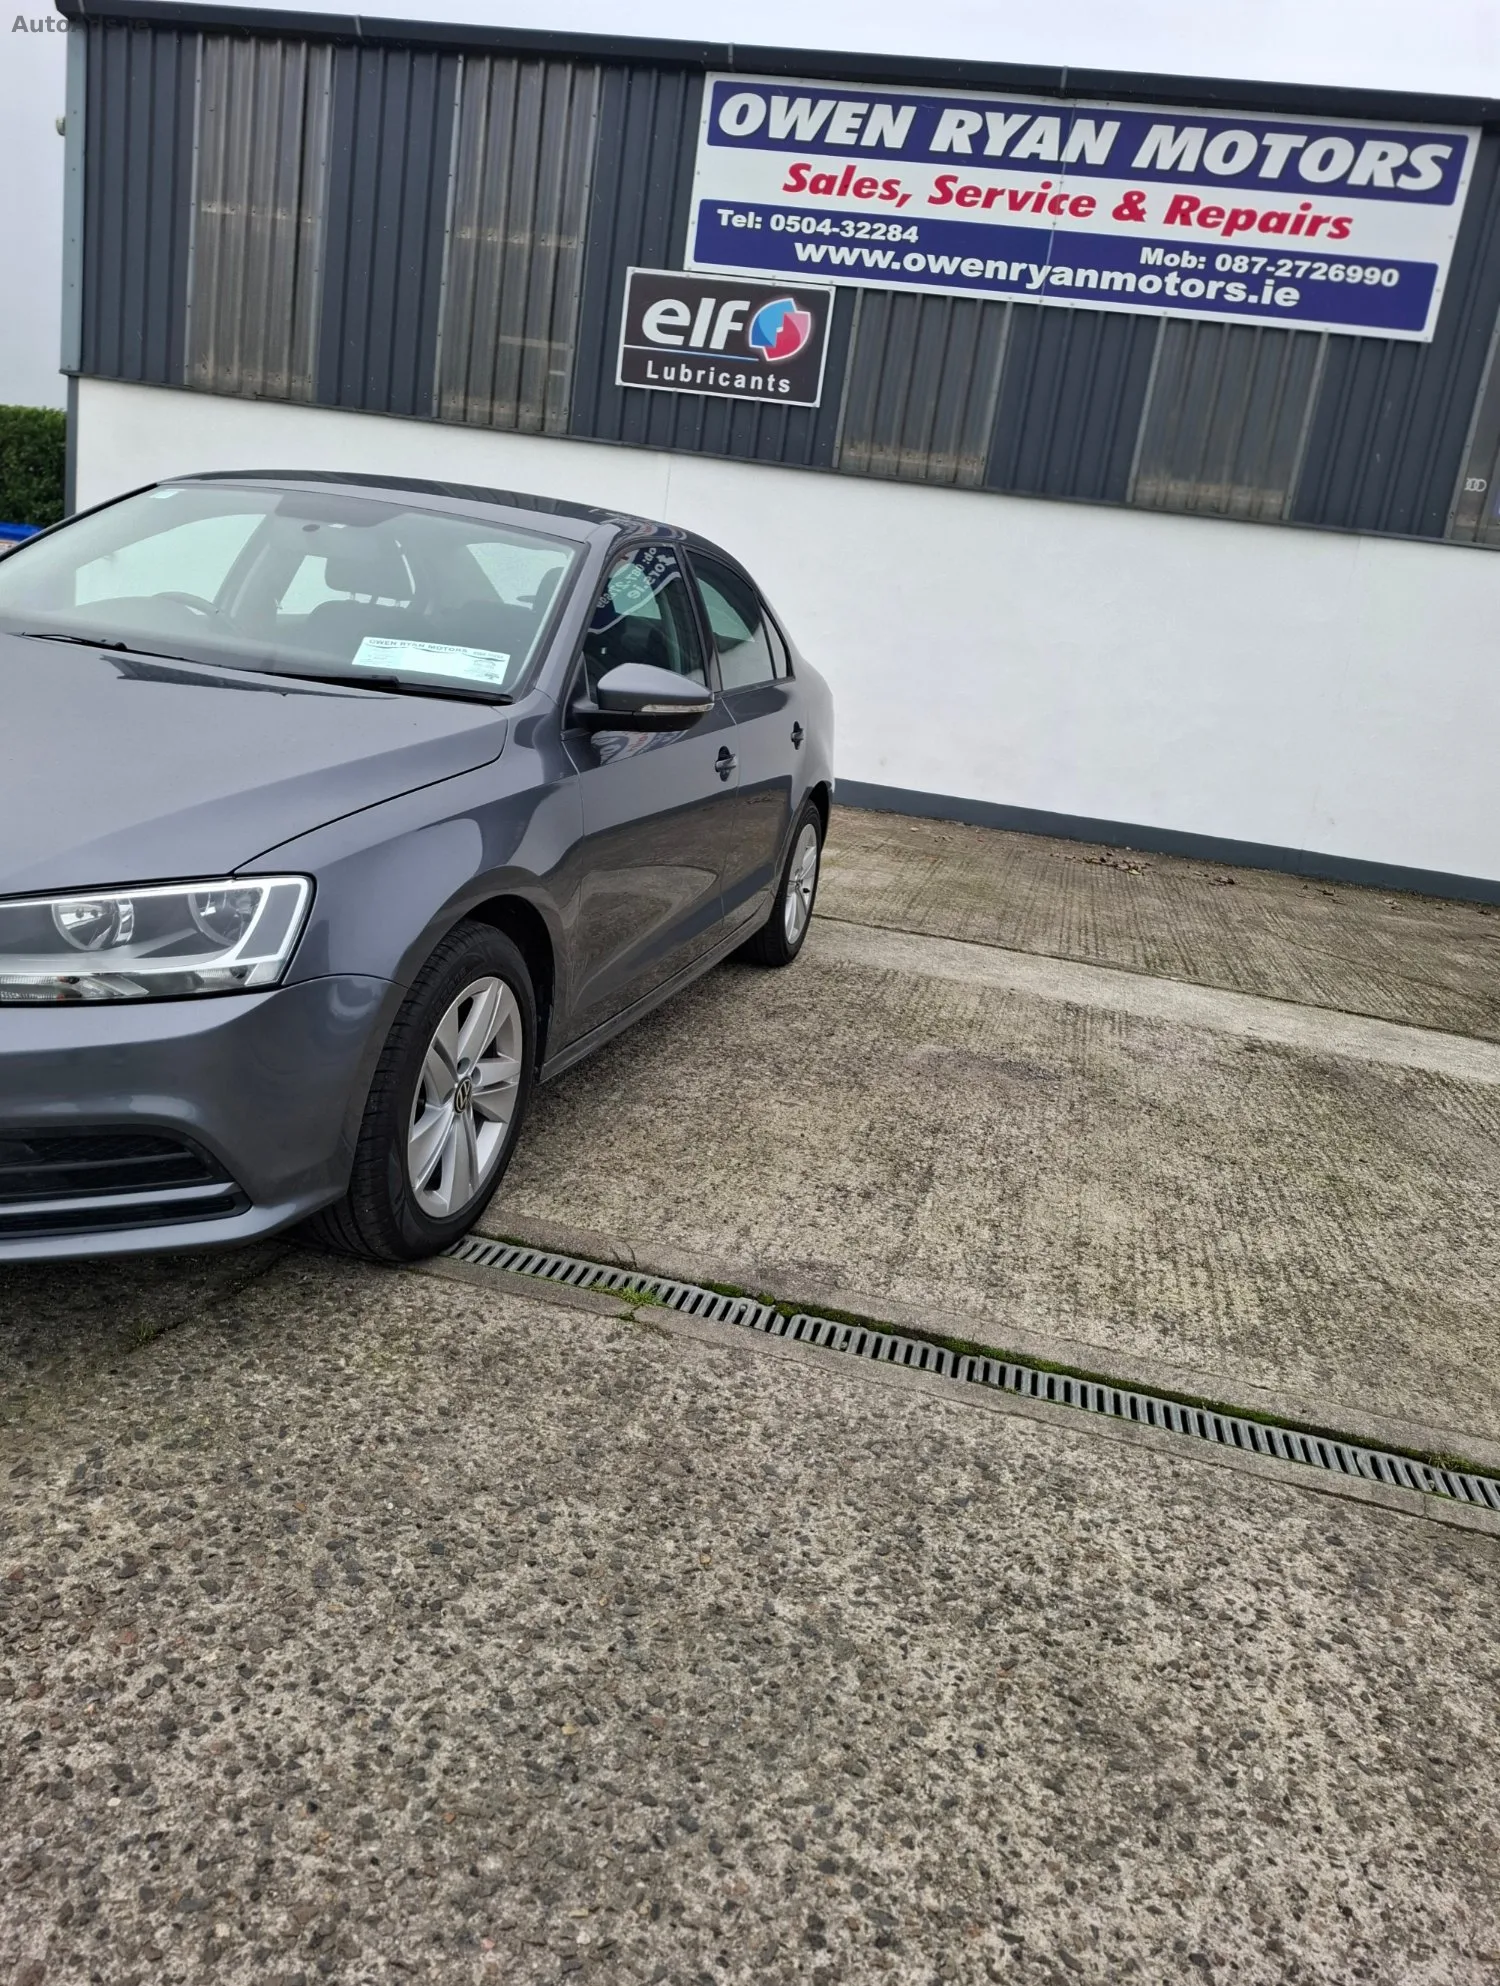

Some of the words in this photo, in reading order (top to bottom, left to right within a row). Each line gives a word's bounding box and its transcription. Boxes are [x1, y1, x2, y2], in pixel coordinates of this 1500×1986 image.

[718, 92, 917, 149] OWEN
[929, 108, 1120, 165] RYAN
[1131, 124, 1453, 191] MOTORS
[782, 162, 912, 208] Sales,
[927, 174, 1096, 217] Service
[1112, 190, 1147, 223] &
[1163, 194, 1353, 239] Repairs
[717, 208, 762, 230] Tel:
[769, 213, 919, 243] 0504-32284
[794, 242, 1300, 307] www.owenryanmotors.ie
[1140, 246, 1206, 270] Mob:
[1215, 253, 1400, 288] 087-2726990
[642, 297, 751, 350] elf
[646, 360, 791, 393] Lubricants
[428, 644, 468, 653] MOTORS
